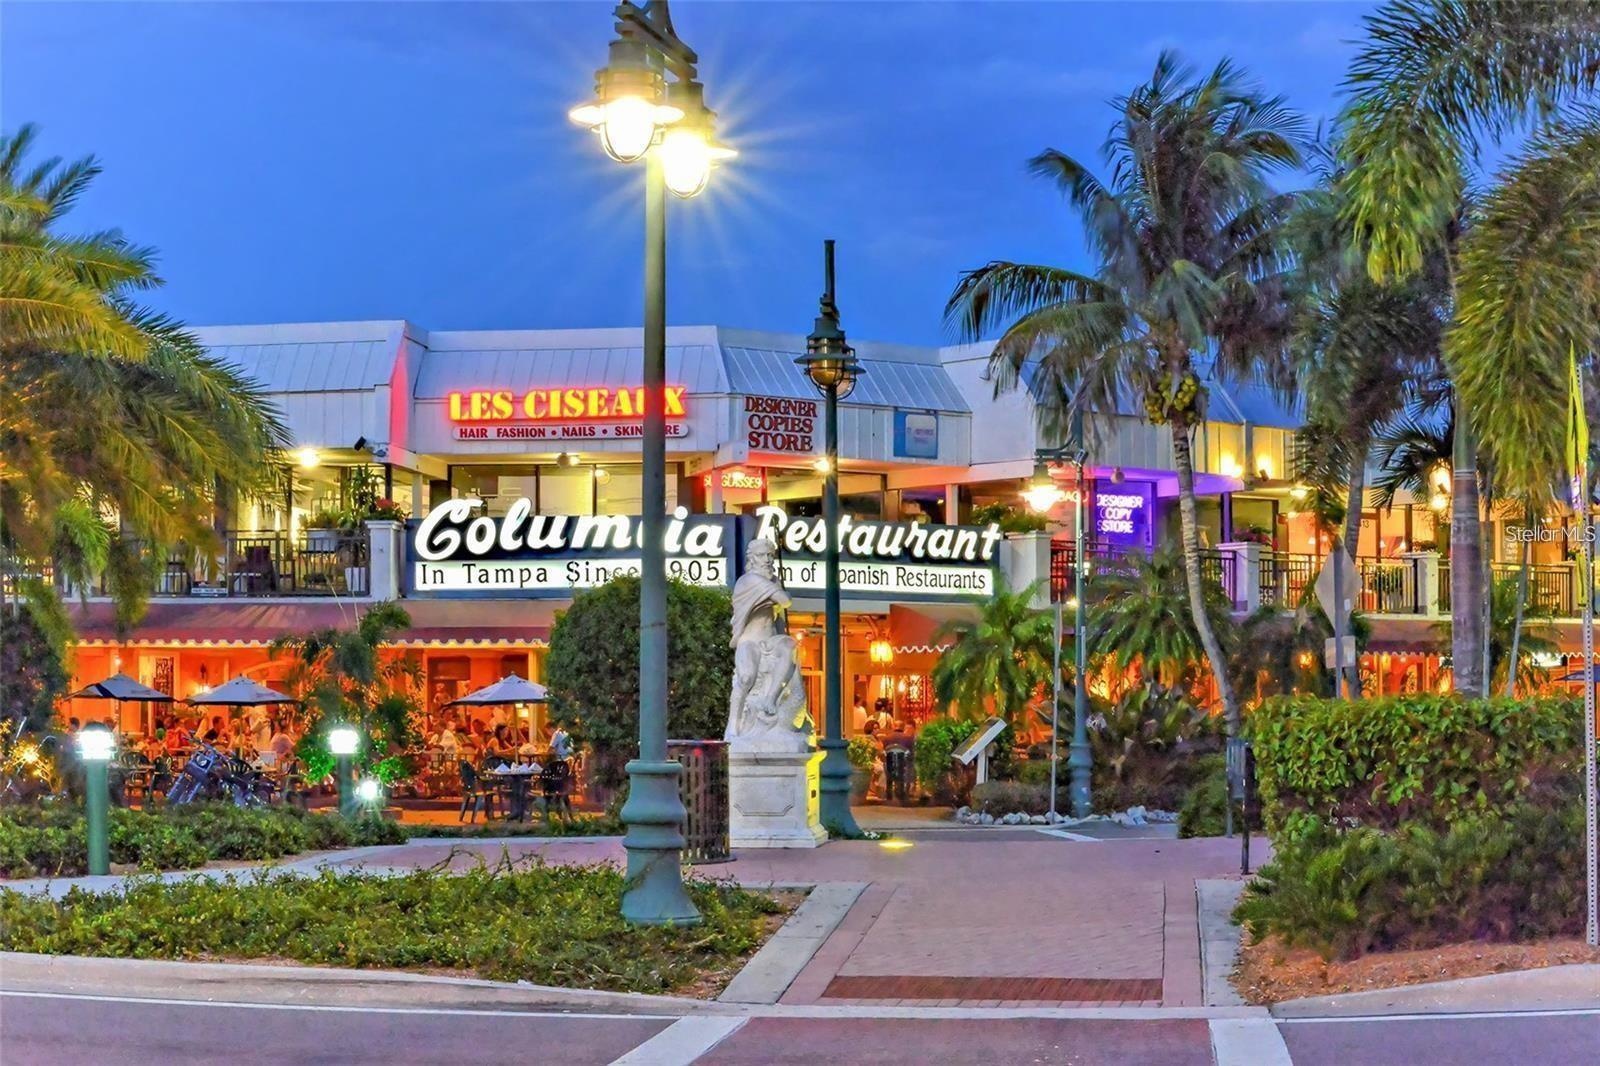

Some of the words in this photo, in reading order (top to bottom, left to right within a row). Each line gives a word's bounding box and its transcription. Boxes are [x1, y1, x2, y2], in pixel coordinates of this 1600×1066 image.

[449, 391, 514, 420] LES
[745, 397, 818, 418] DESIGNER
[459, 428, 488, 438] HAIR
[496, 427, 546, 438] FASHION
[562, 426, 596, 437] NAILS
[615, 425, 643, 436] SKIN
[664, 424, 680, 435] RE
[748, 414, 813, 434] COPIES
[748, 431, 813, 451] STORE
[1096, 494, 1143, 508] DESIGNER
[1104, 507, 1132, 520] COPY
[415, 498, 723, 561] Columia
[756, 505, 1001, 561] Restaurant
[1101, 520, 1134, 533] STORE
[421, 564, 444, 585] In
[462, 563, 548, 588] Tampa
[566, 560, 638, 584] Since
[669, 560, 720, 582] 905
[801, 561, 817, 582] of
[838, 565, 889, 587] panish
[896, 566, 986, 590] Restaurants
